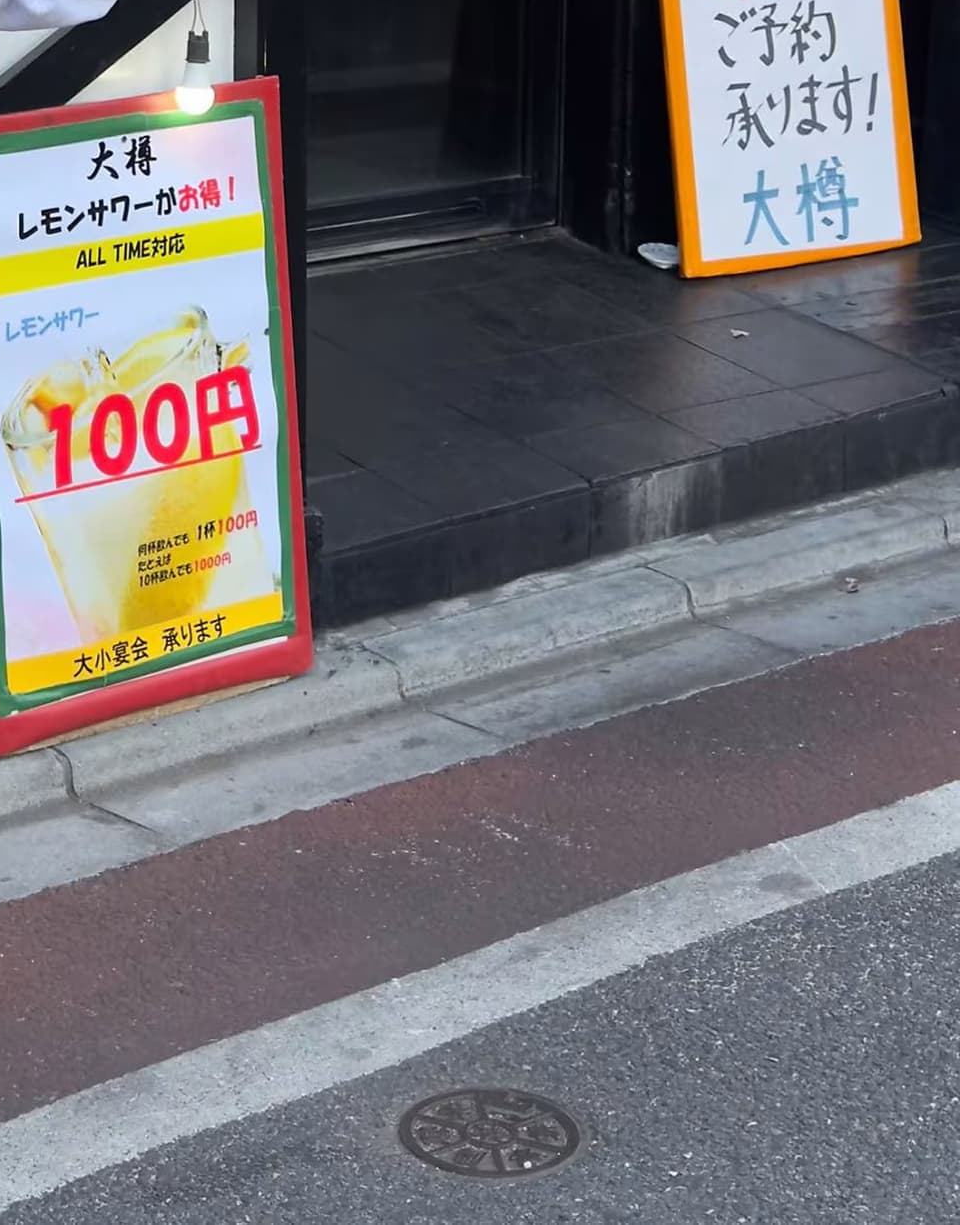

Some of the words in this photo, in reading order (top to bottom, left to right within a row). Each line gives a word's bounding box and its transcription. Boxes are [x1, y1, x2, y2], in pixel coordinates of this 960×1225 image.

[713, 0, 838, 68] ご予約
[87, 136, 157, 180] 大樽
[743, 155, 860, 246] 大樽
[76, 248, 106, 269] ALL
[113, 233, 185, 262] TIME対応
[5, 307, 100, 342] レモンサワー
[48, 365, 259, 488] 100円
[138, 533, 190, 557] 何杯飲んでも
[138, 553, 172, 572] たとえば
[73, 636, 148, 677] 大小宴会
[162, 614, 226, 652] 承ります
